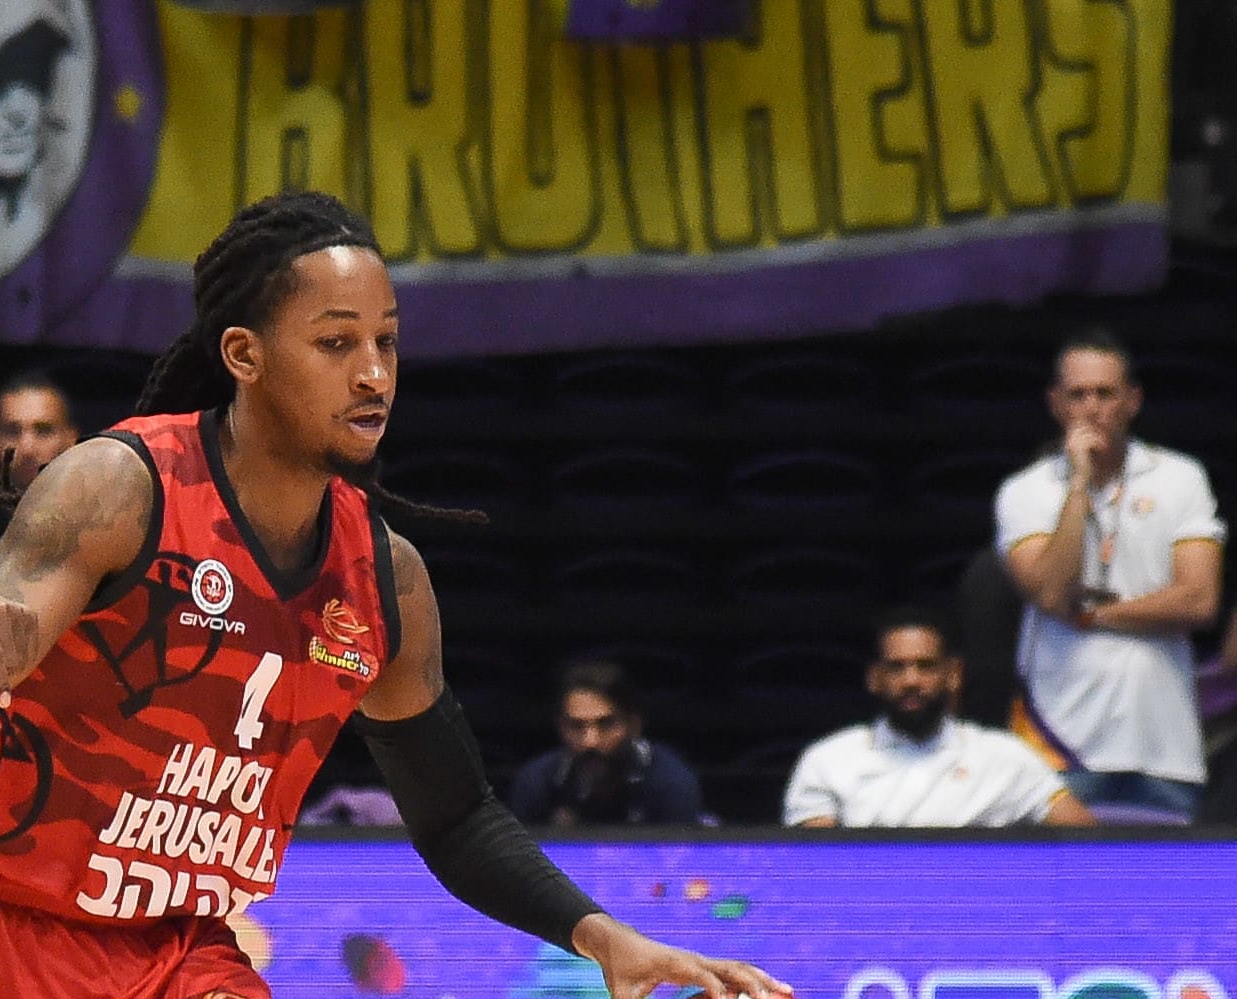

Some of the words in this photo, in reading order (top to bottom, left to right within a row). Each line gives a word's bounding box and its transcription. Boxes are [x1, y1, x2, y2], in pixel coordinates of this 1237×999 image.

[179, 611, 246, 635] GIVOVA
[233, 651, 283, 750] 4
[98, 791, 277, 884] JERUSALE
